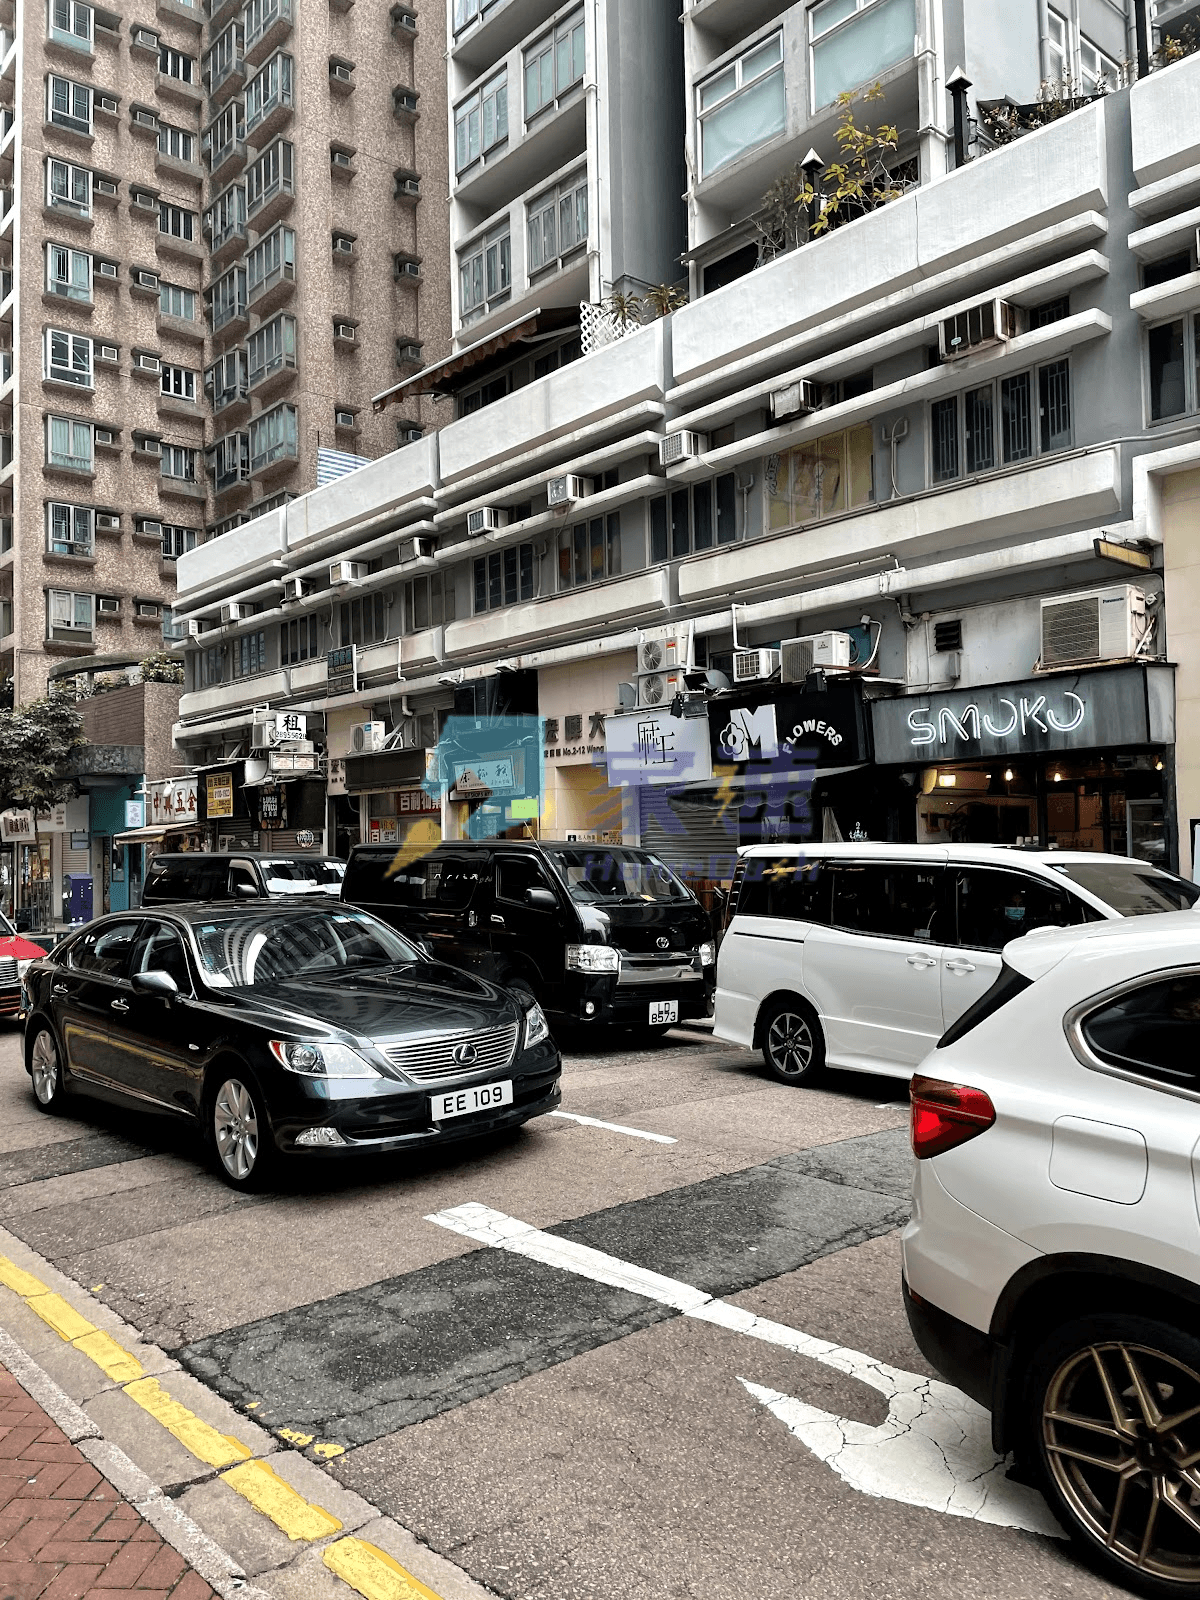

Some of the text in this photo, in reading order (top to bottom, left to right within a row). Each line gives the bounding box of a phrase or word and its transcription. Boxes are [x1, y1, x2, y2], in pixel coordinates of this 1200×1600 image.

[282, 714, 302, 732] 租
[730, 704, 843, 761] M FLOWERS
[907, 691, 1085, 745] SMOKO
[651, 1011, 676, 1023] 8573
[443, 1086, 503, 1115] EE 109
